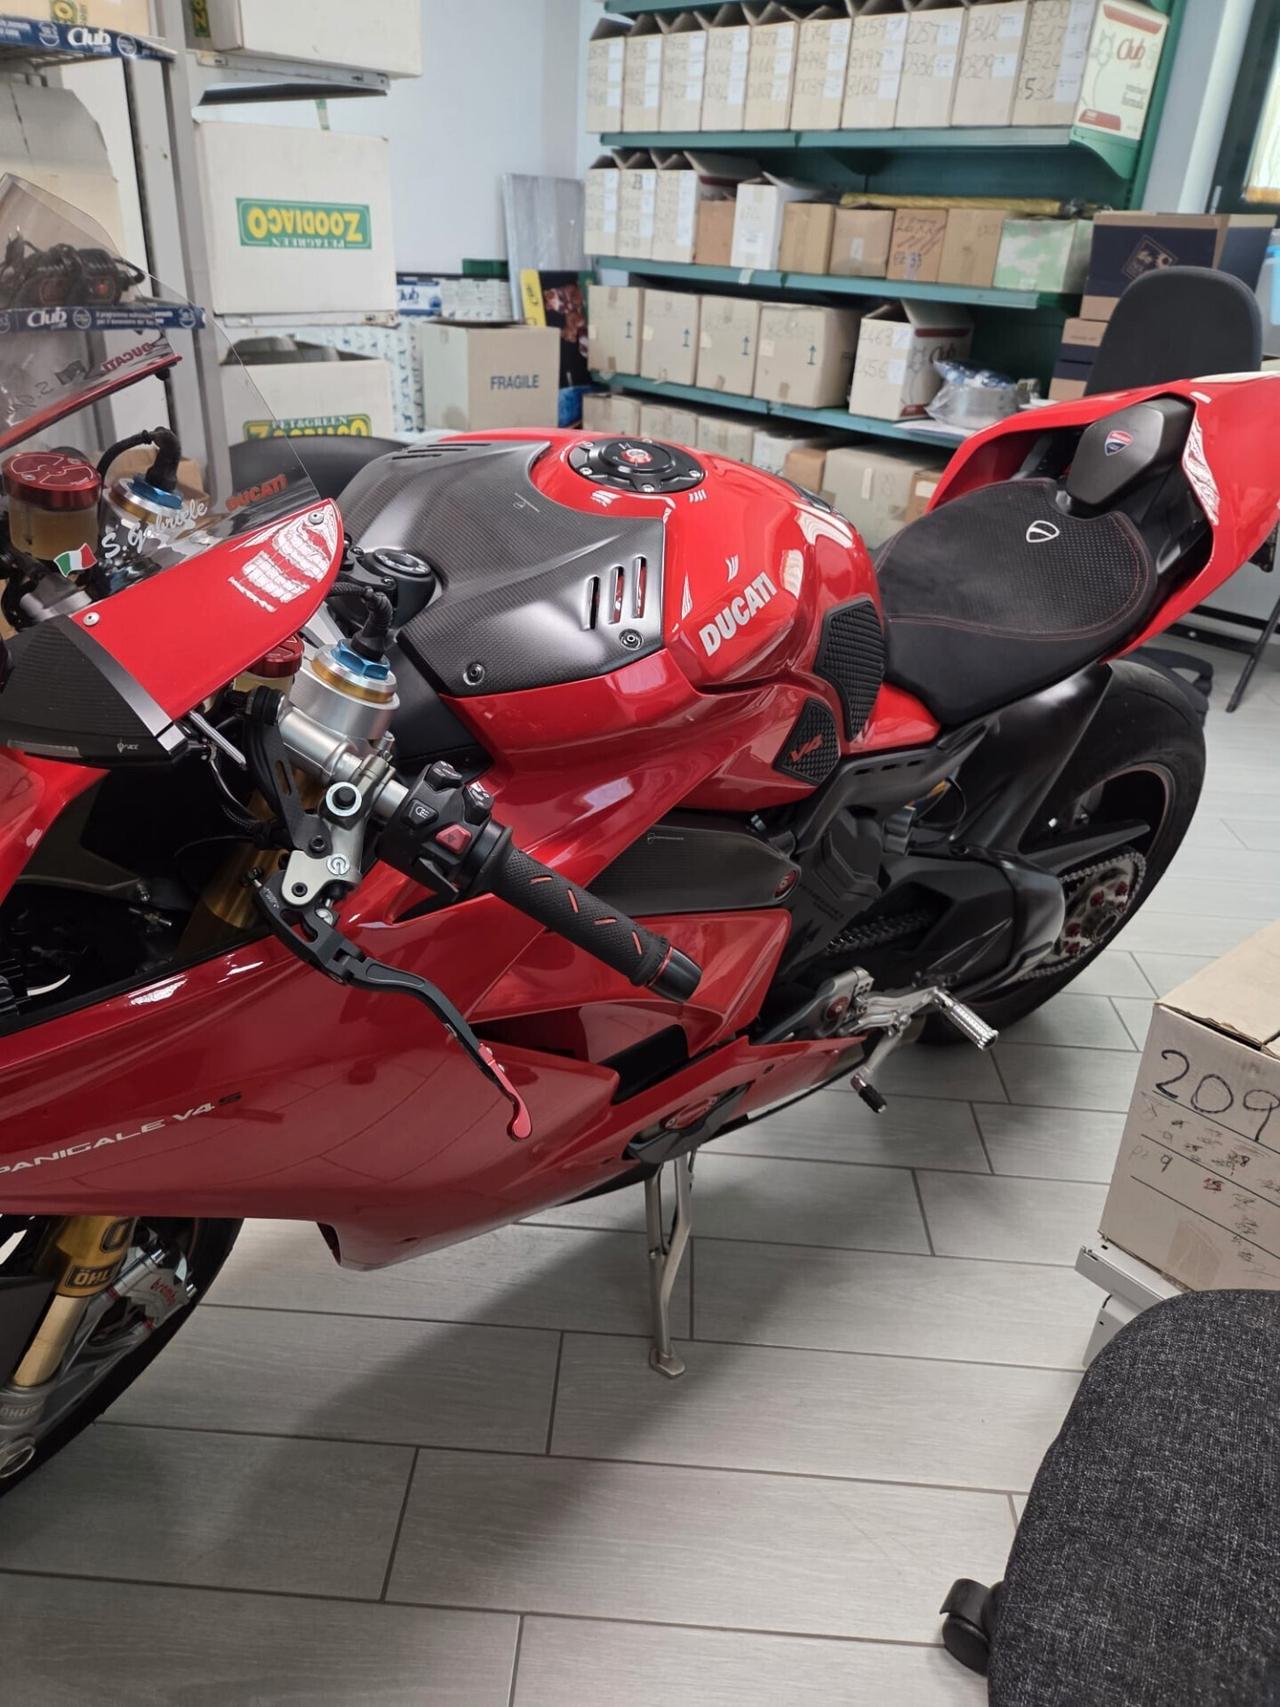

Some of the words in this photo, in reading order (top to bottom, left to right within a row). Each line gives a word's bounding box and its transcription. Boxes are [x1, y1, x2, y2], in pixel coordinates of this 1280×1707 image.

[67, 27, 112, 47] Club
[1116, 37, 1147, 61] Club
[246, 206, 364, 243] ZOODIACO
[27, 307, 68, 328] Club
[490, 375, 540, 390] FRAGILE
[699, 571, 778, 657] DUCATI
[1154, 1049, 1280, 1142] 209
[172, 1102, 215, 1121] V4
